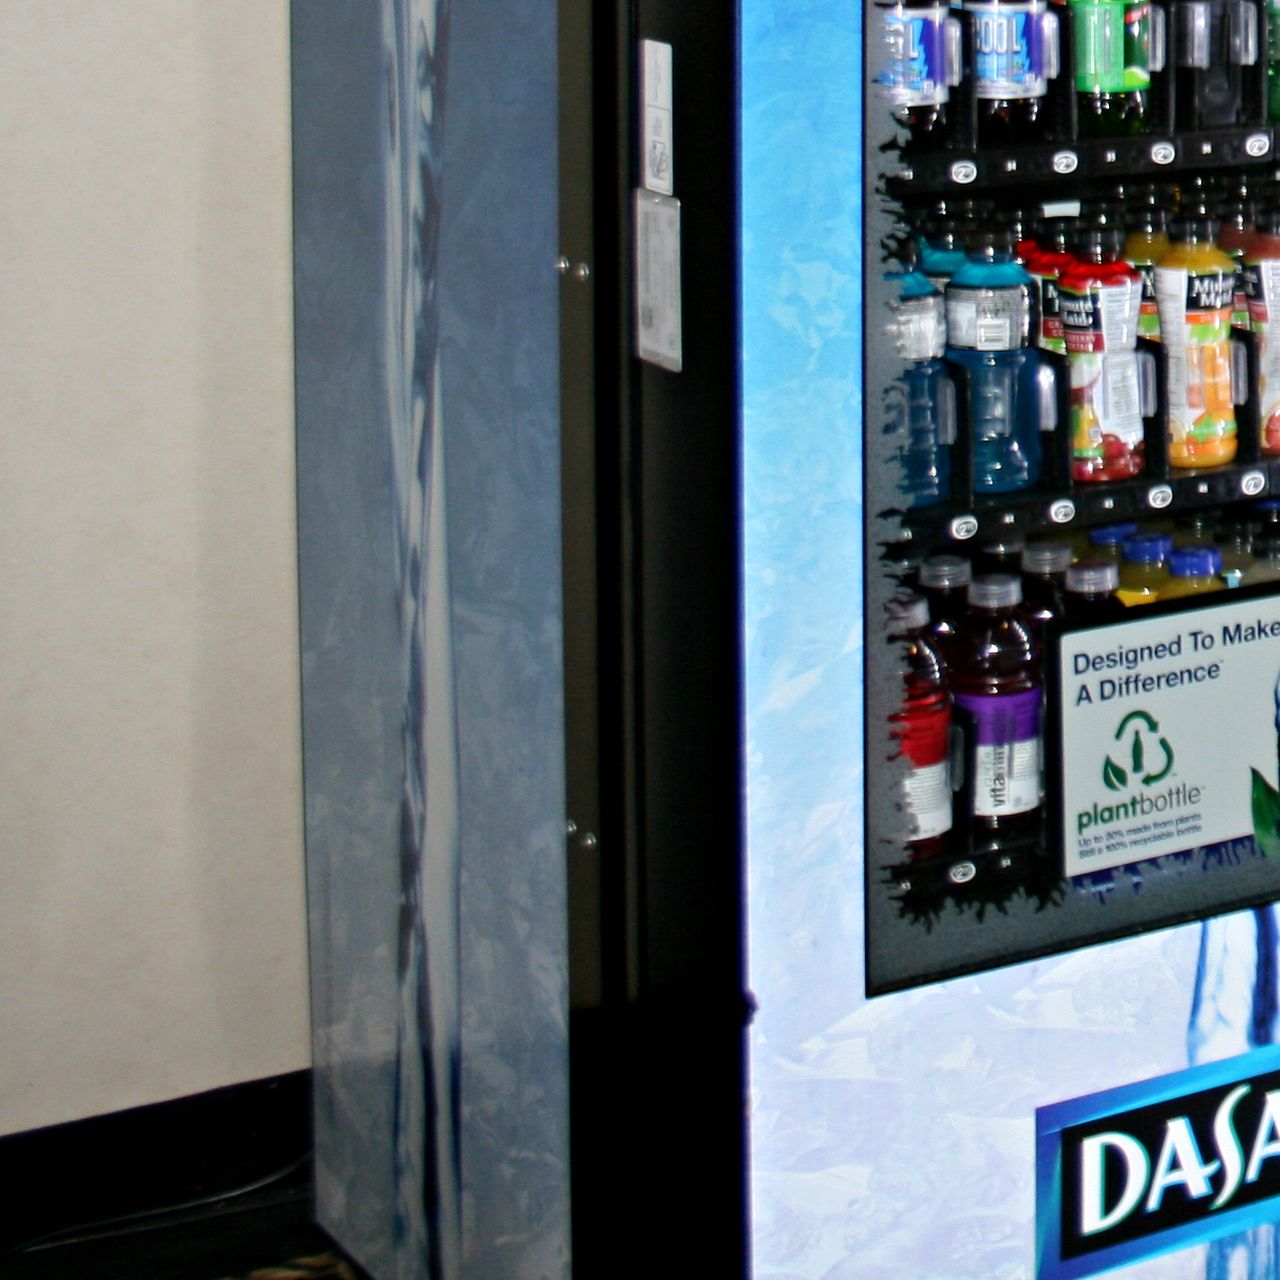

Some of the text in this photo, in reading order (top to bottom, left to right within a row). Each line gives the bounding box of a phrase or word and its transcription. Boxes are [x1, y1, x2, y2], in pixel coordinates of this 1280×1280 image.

[1073, 634, 1182, 676] Designed
[1188, 631, 1215, 653] To
[1075, 663, 1221, 707] A Difference
[1078, 784, 1201, 836] plantbottle
[1079, 837, 1092, 848] Up
[1126, 825, 1152, 836] made
[1153, 820, 1174, 830] from
[1175, 813, 1202, 827] plants
